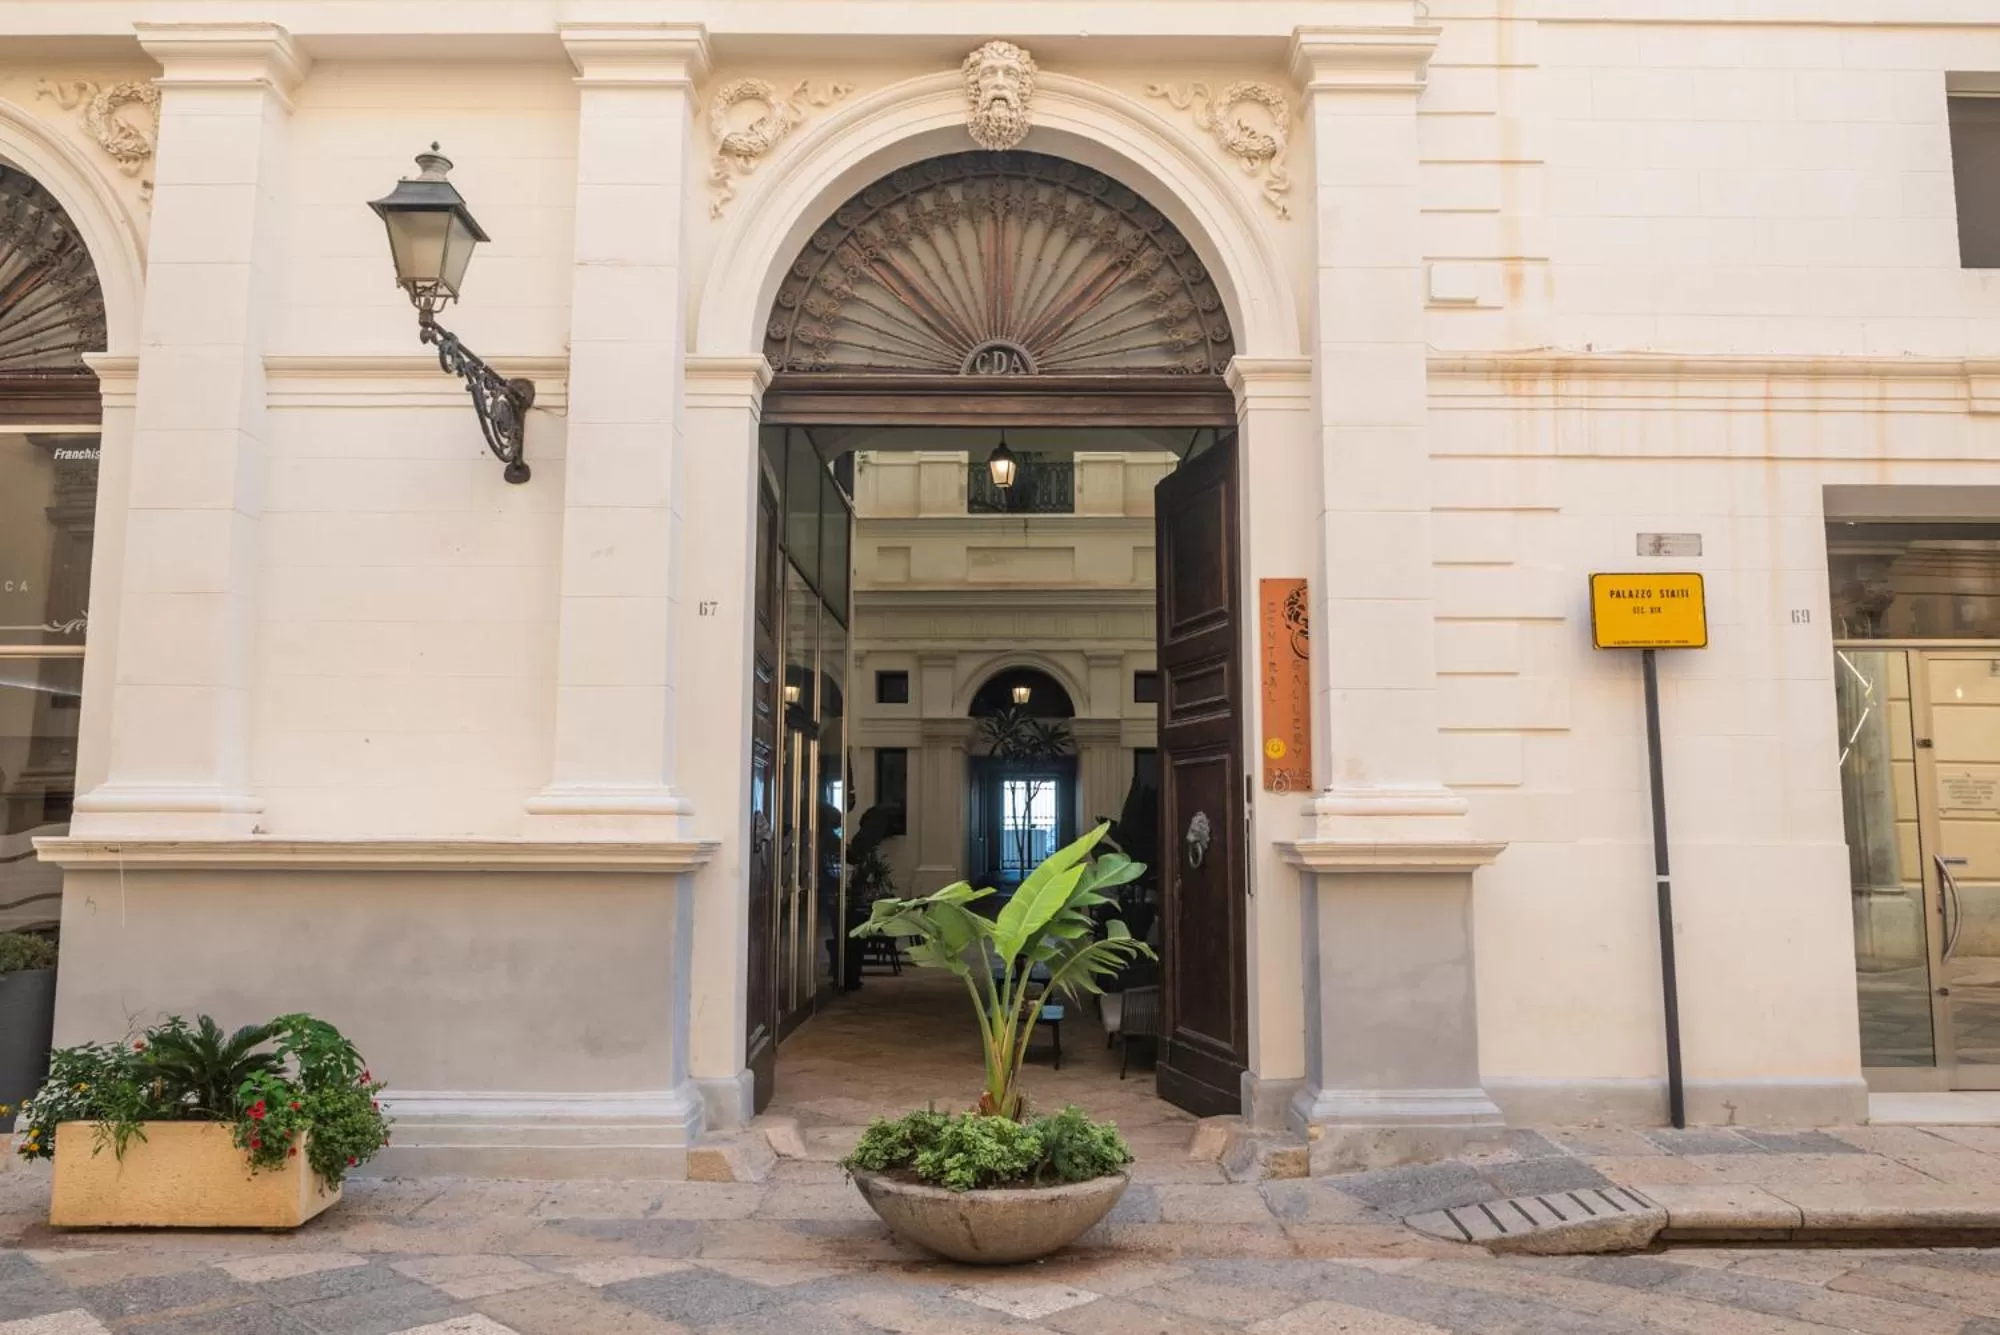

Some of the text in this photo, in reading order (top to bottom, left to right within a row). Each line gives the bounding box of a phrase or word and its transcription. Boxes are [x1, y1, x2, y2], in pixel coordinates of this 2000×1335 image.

[1609, 589, 1653, 599] PALAZZO
[699, 600, 719, 617] 67
[1791, 609, 1811, 624] 69
[1267, 601, 1278, 703] CENTRAL
